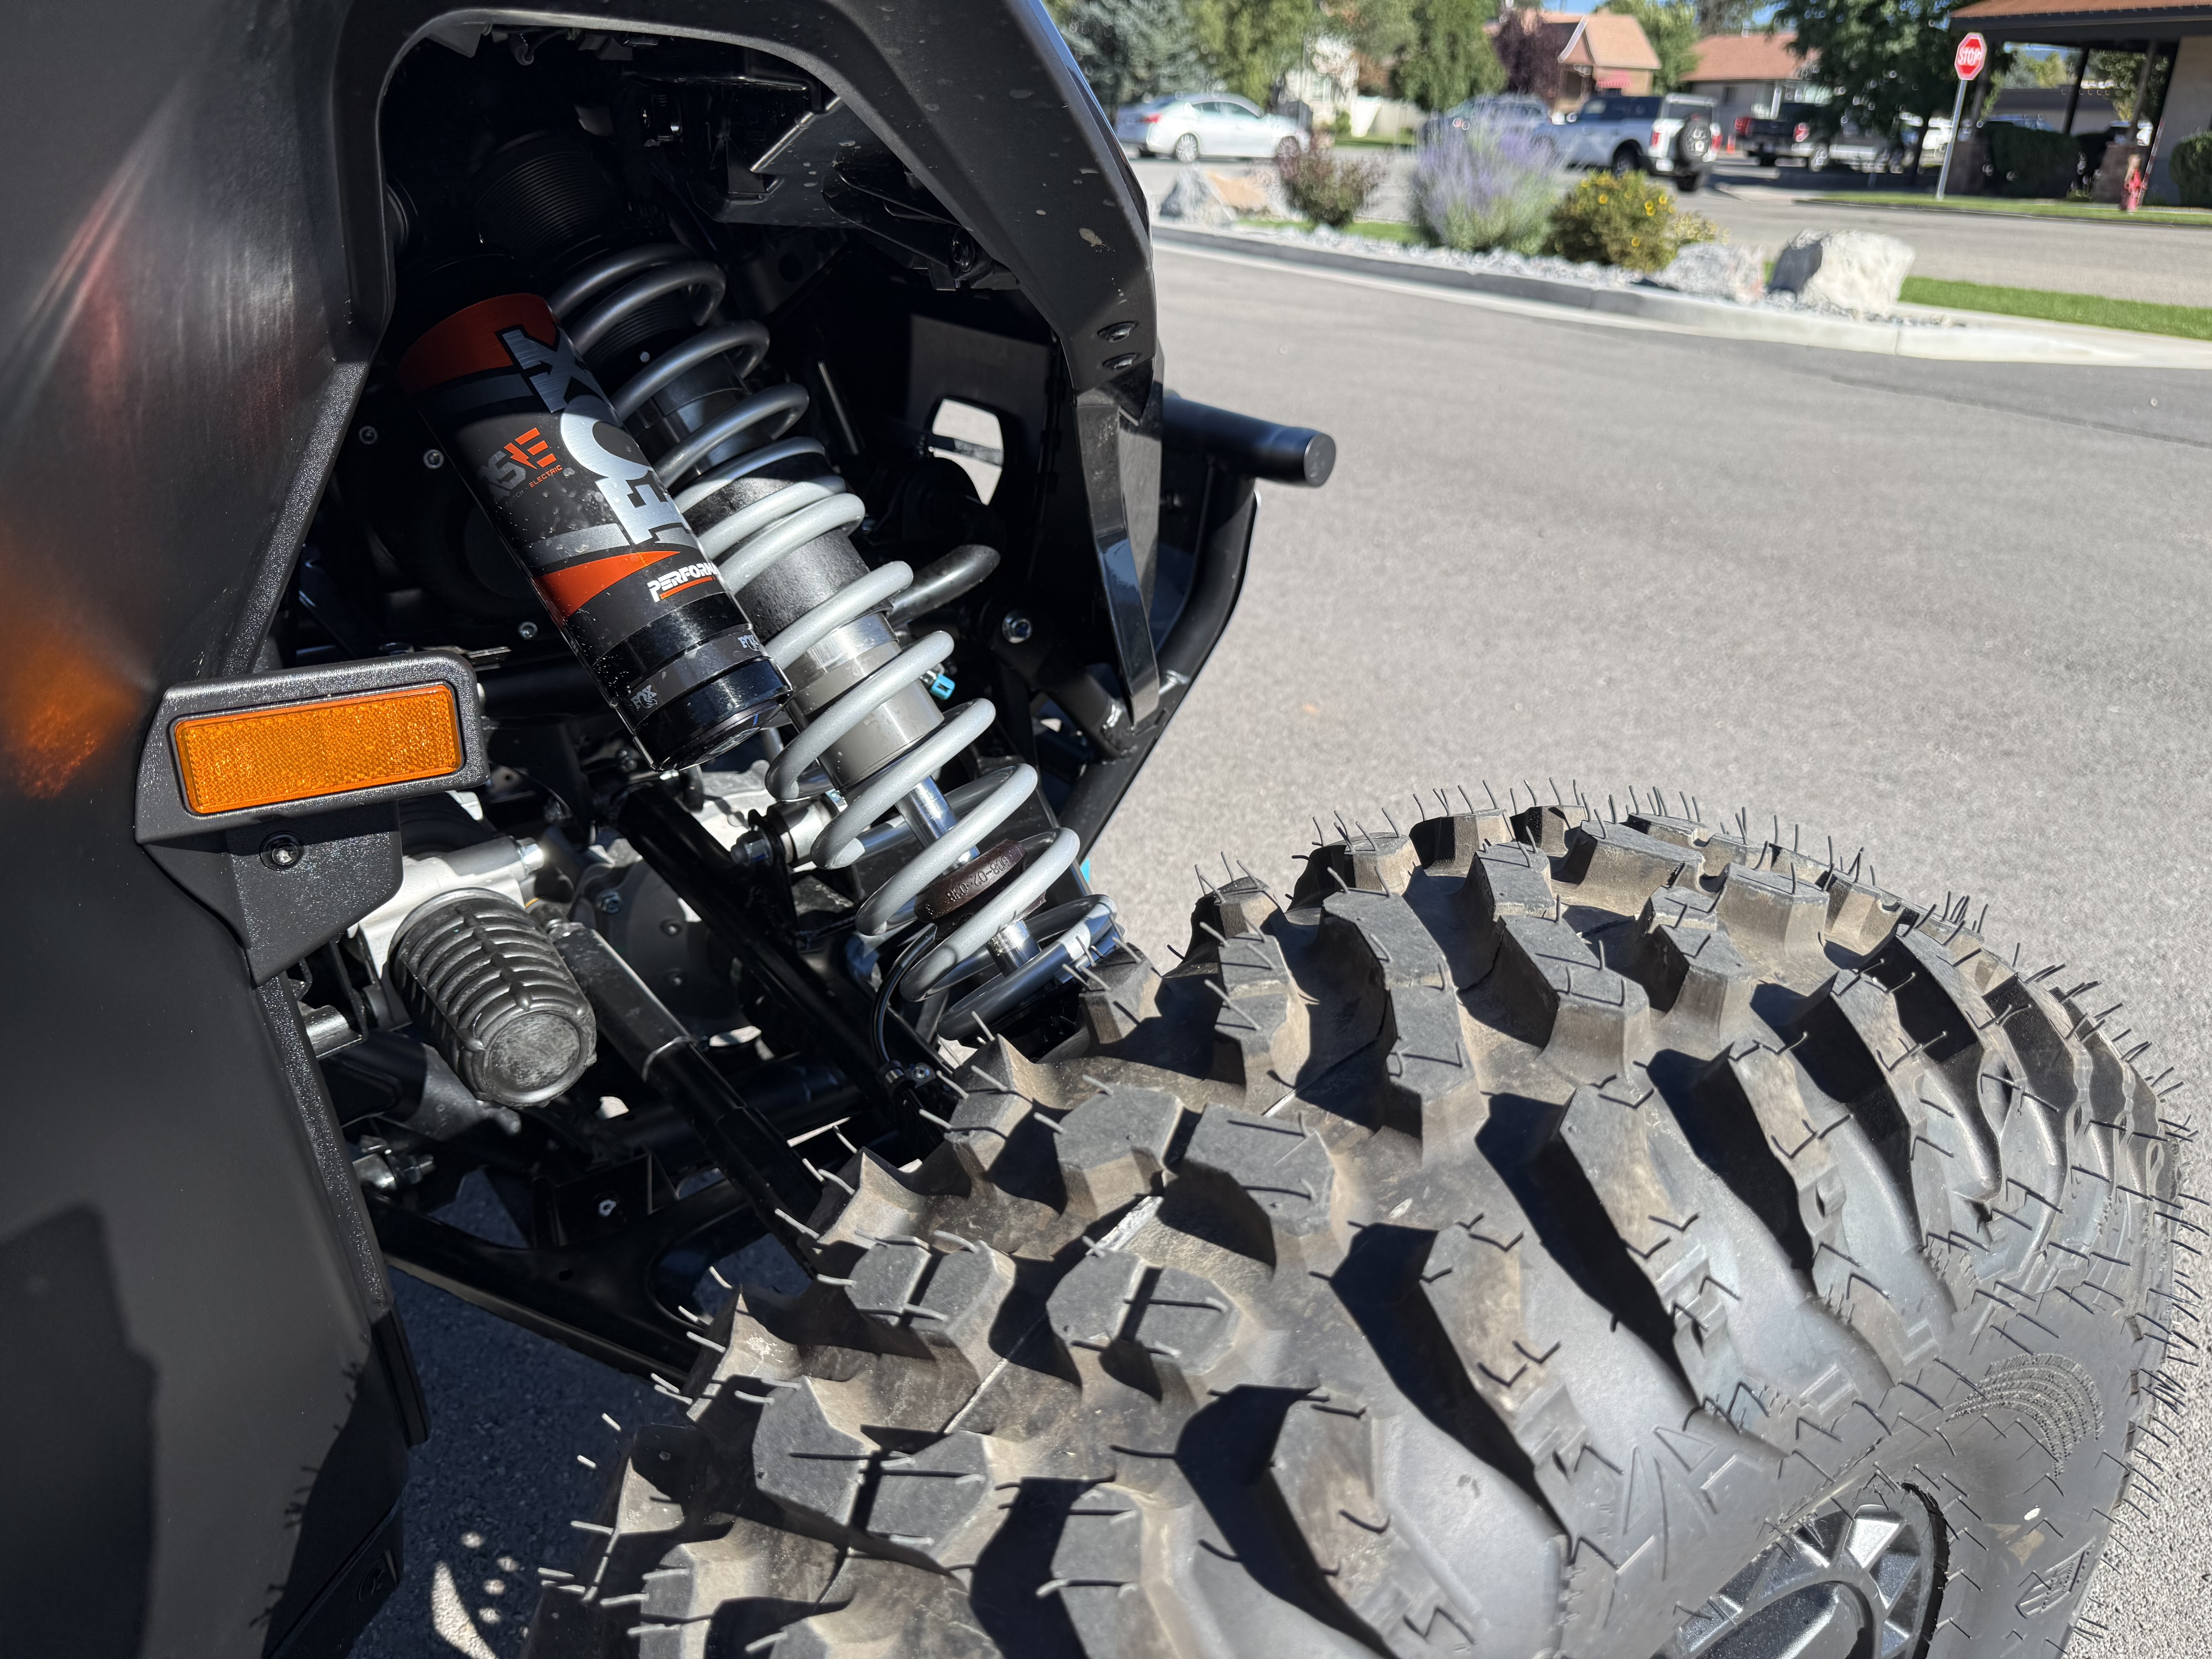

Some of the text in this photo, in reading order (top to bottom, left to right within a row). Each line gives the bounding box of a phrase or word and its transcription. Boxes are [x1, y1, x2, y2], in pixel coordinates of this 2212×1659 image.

[1957, 46, 1982, 66] STOP
[529, 464, 563, 488] ELECTRIC
[737, 635, 761, 651] FOX
[631, 684, 658, 710] FOX
